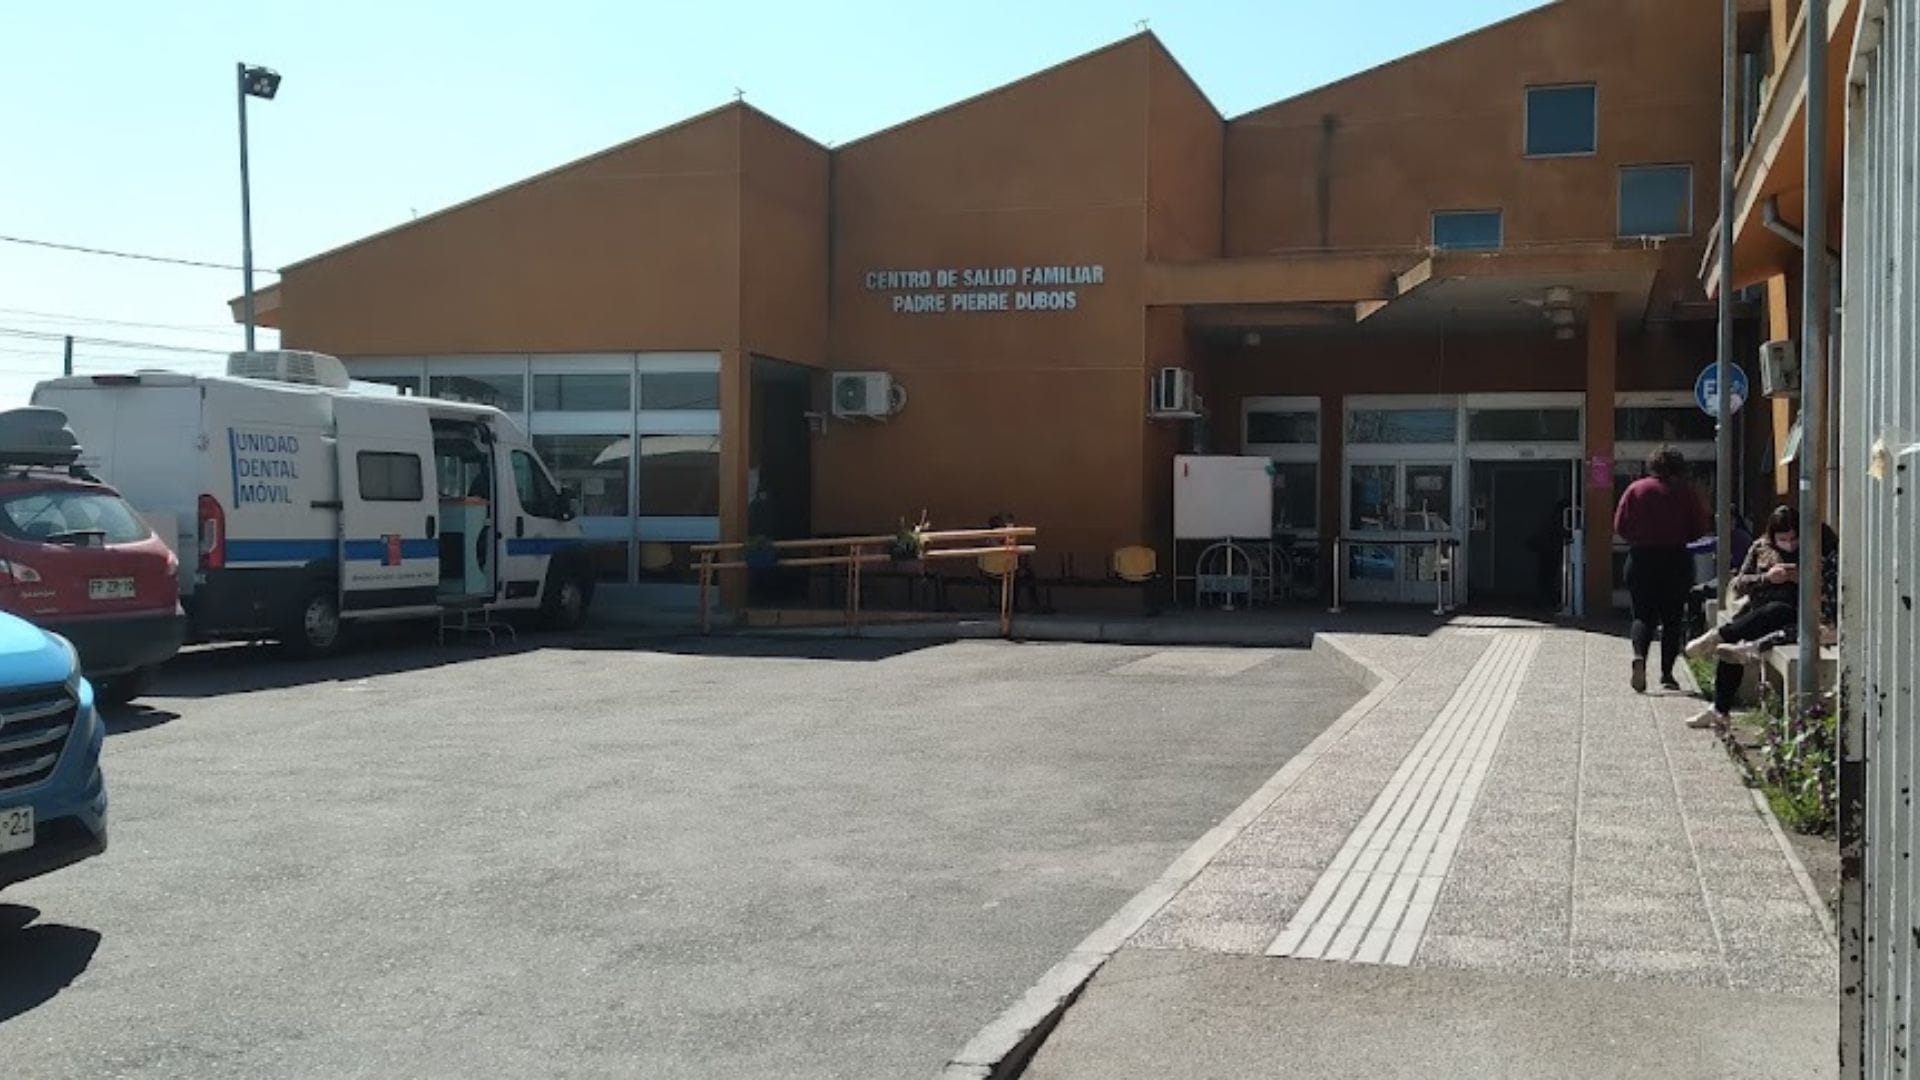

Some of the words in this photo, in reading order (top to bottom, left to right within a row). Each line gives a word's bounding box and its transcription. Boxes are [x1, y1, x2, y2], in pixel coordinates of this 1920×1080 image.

[865, 269, 931, 290] CENTRO
[936, 268, 959, 288] DE
[962, 267, 1017, 287] SALUD
[1022, 264, 1105, 285] FAMILIAR
[892, 293, 946, 313] PADRE
[951, 292, 1009, 312] PIERRE
[1015, 290, 1078, 310] DUBOIS
[235, 432, 299, 454] UNIDAD
[238, 457, 299, 479] DENTAL
[239, 480, 293, 504] MÓVIL
